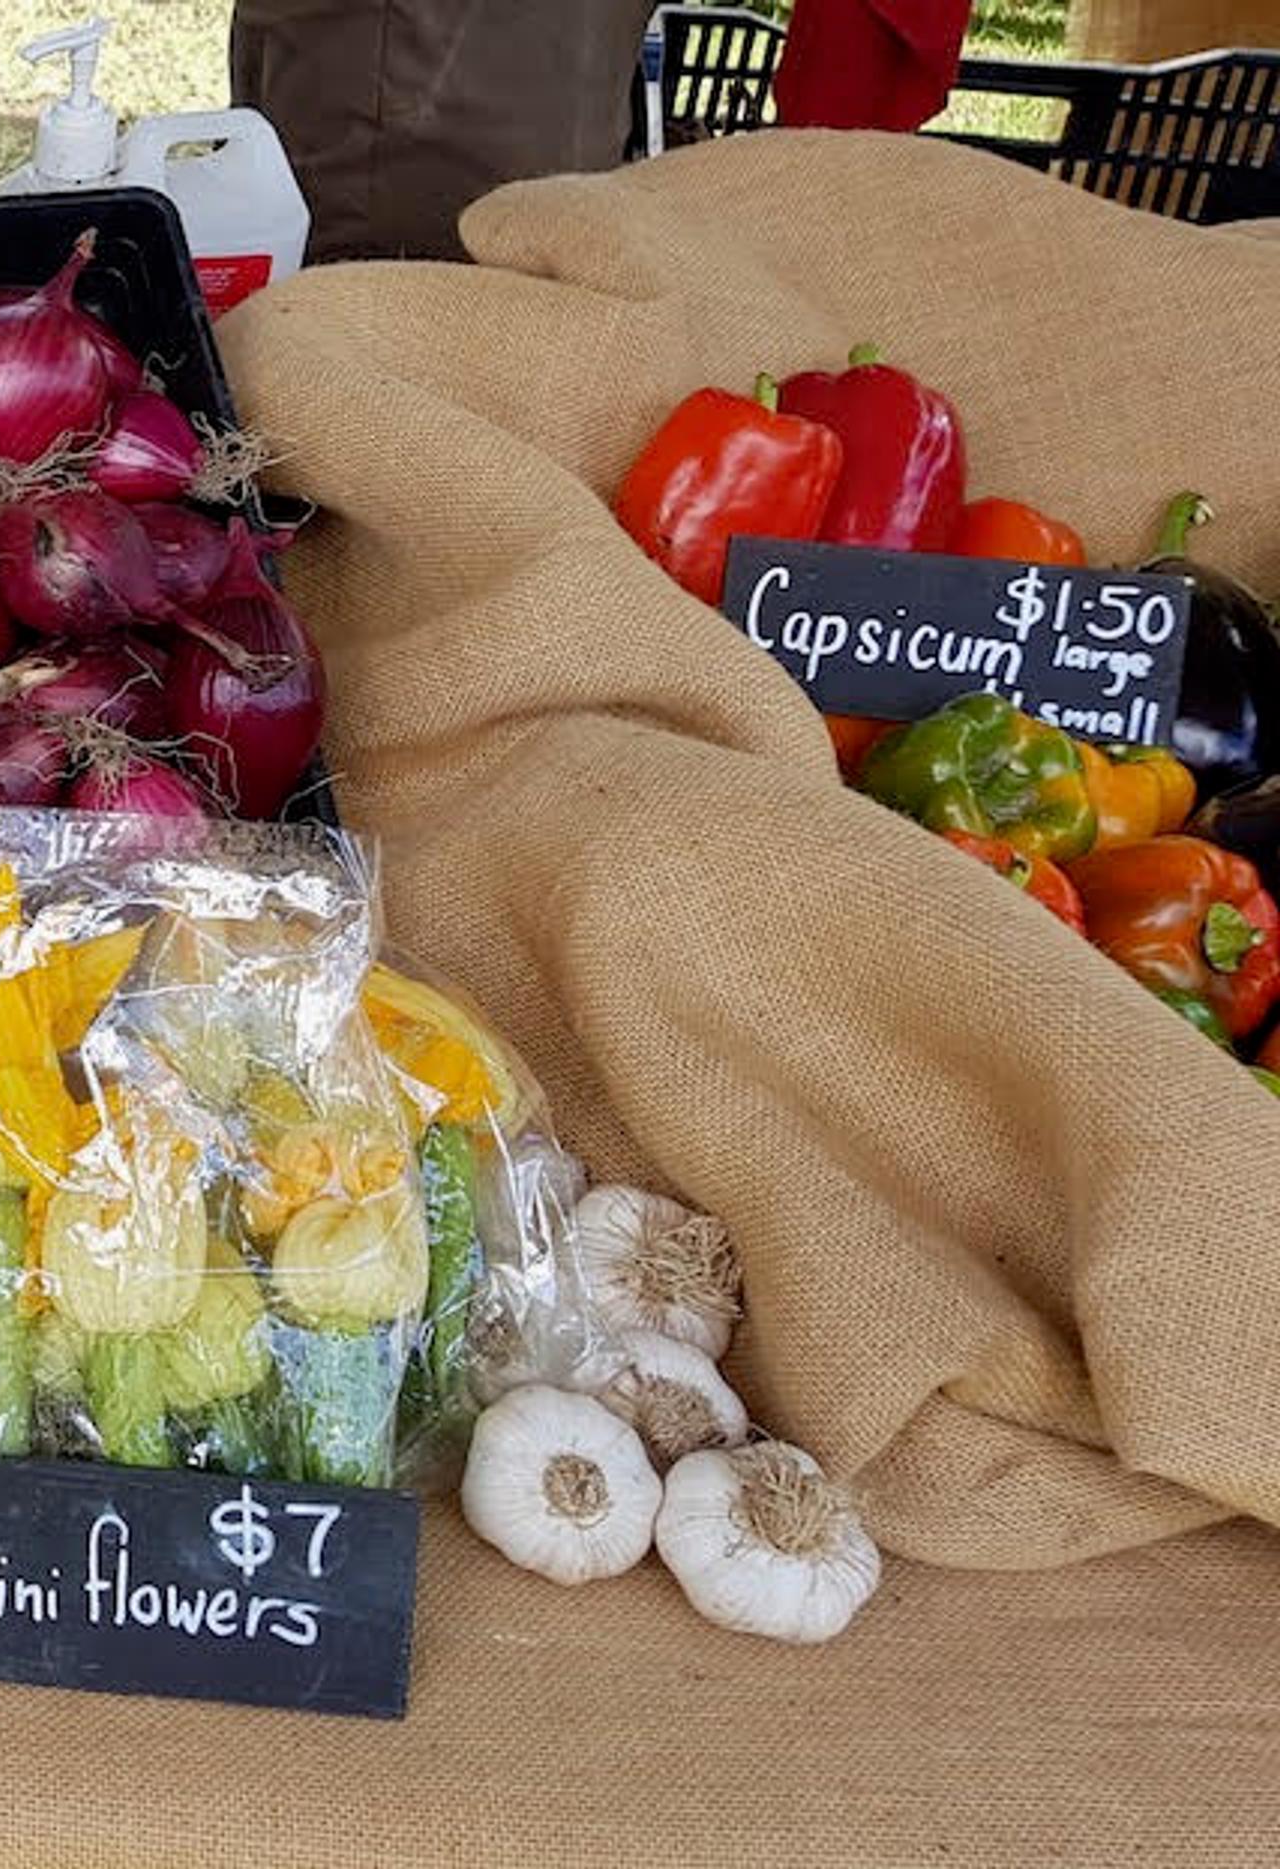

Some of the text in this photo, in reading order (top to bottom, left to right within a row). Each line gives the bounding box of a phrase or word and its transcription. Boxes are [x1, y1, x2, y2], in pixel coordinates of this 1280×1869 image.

[746, 566, 1024, 683] Capsicum
[1052, 635, 1154, 696] large
[1035, 695, 1159, 745] small
[210, 1483, 342, 1578] $7
[83, 1513, 321, 1647] flowers
